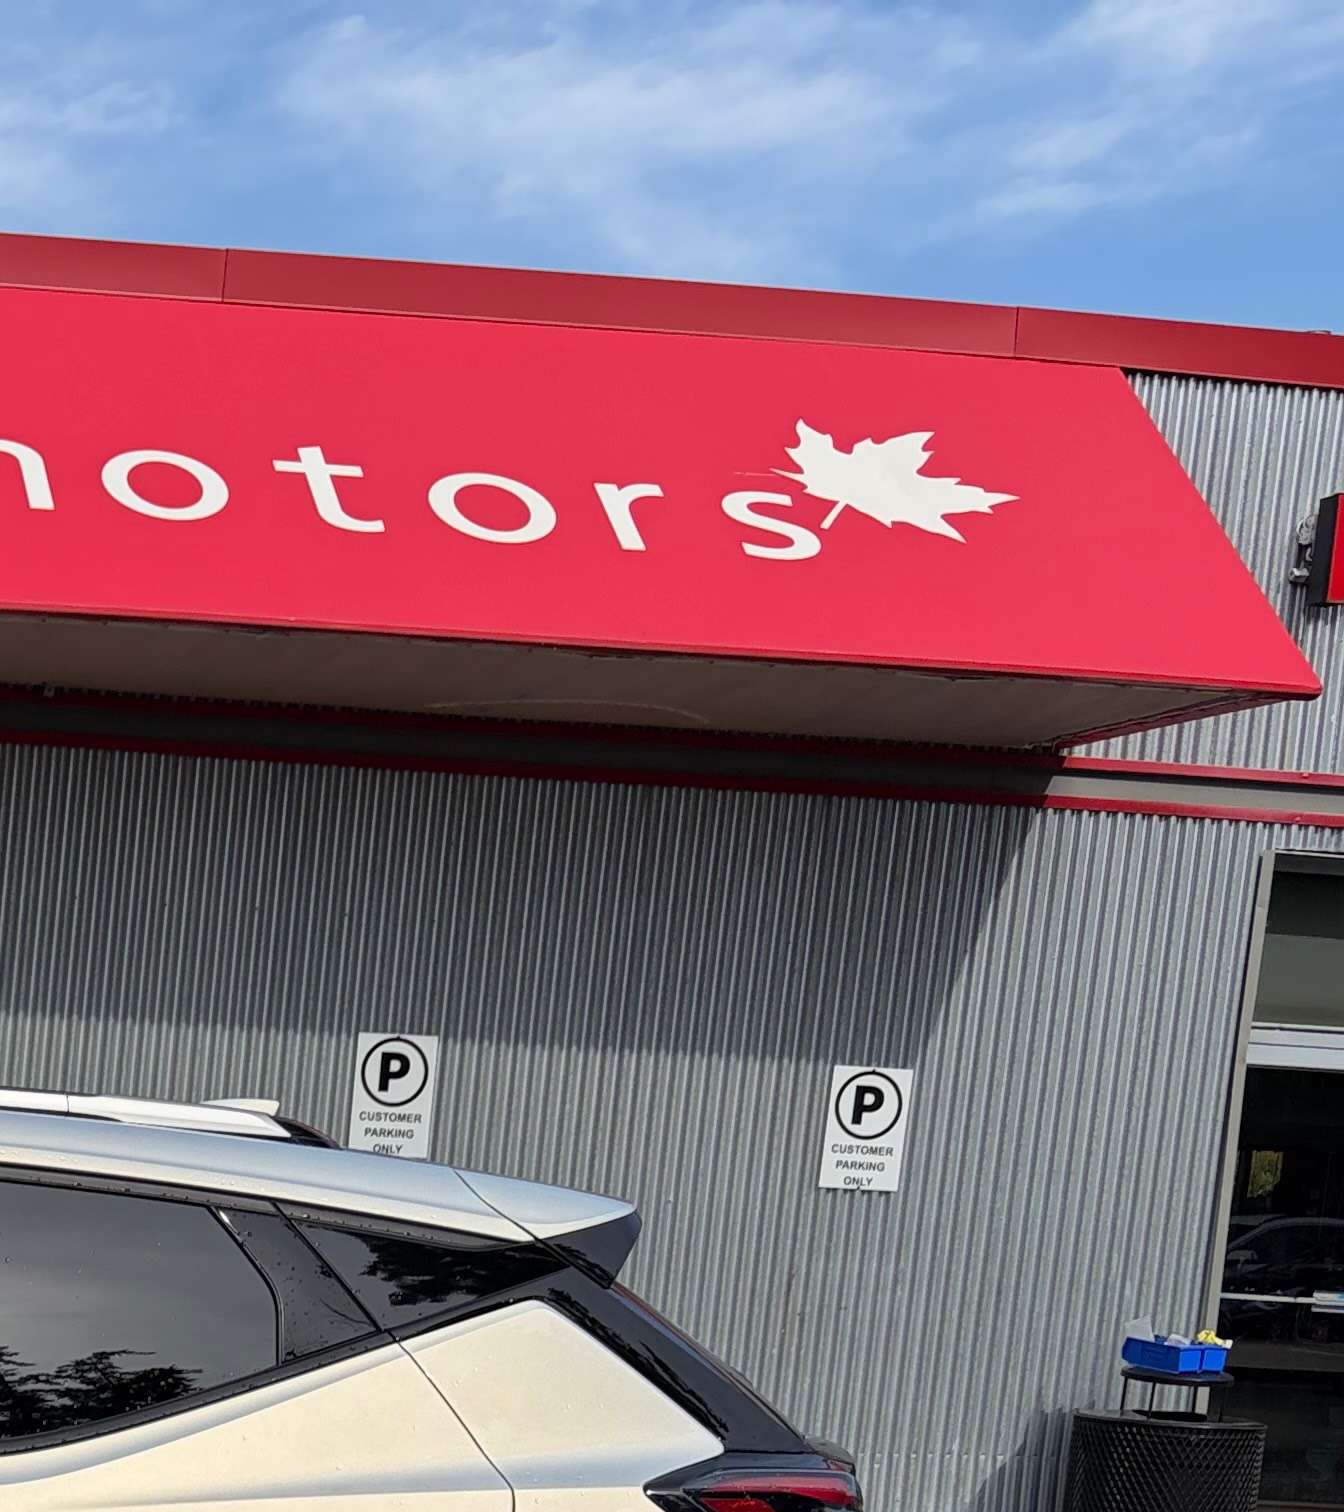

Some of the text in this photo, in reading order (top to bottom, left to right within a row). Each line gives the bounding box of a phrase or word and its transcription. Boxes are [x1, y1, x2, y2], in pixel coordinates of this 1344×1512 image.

[377, 1051, 411, 1092] P
[850, 1084, 885, 1126] P
[358, 1110, 423, 1124] CUSTOMER
[363, 1127, 415, 1139] PARKING
[372, 1143, 404, 1154] ONLY
[831, 1143, 894, 1157] CUSTOMER
[835, 1159, 886, 1172] PARKING
[843, 1175, 874, 1187] ONLY
